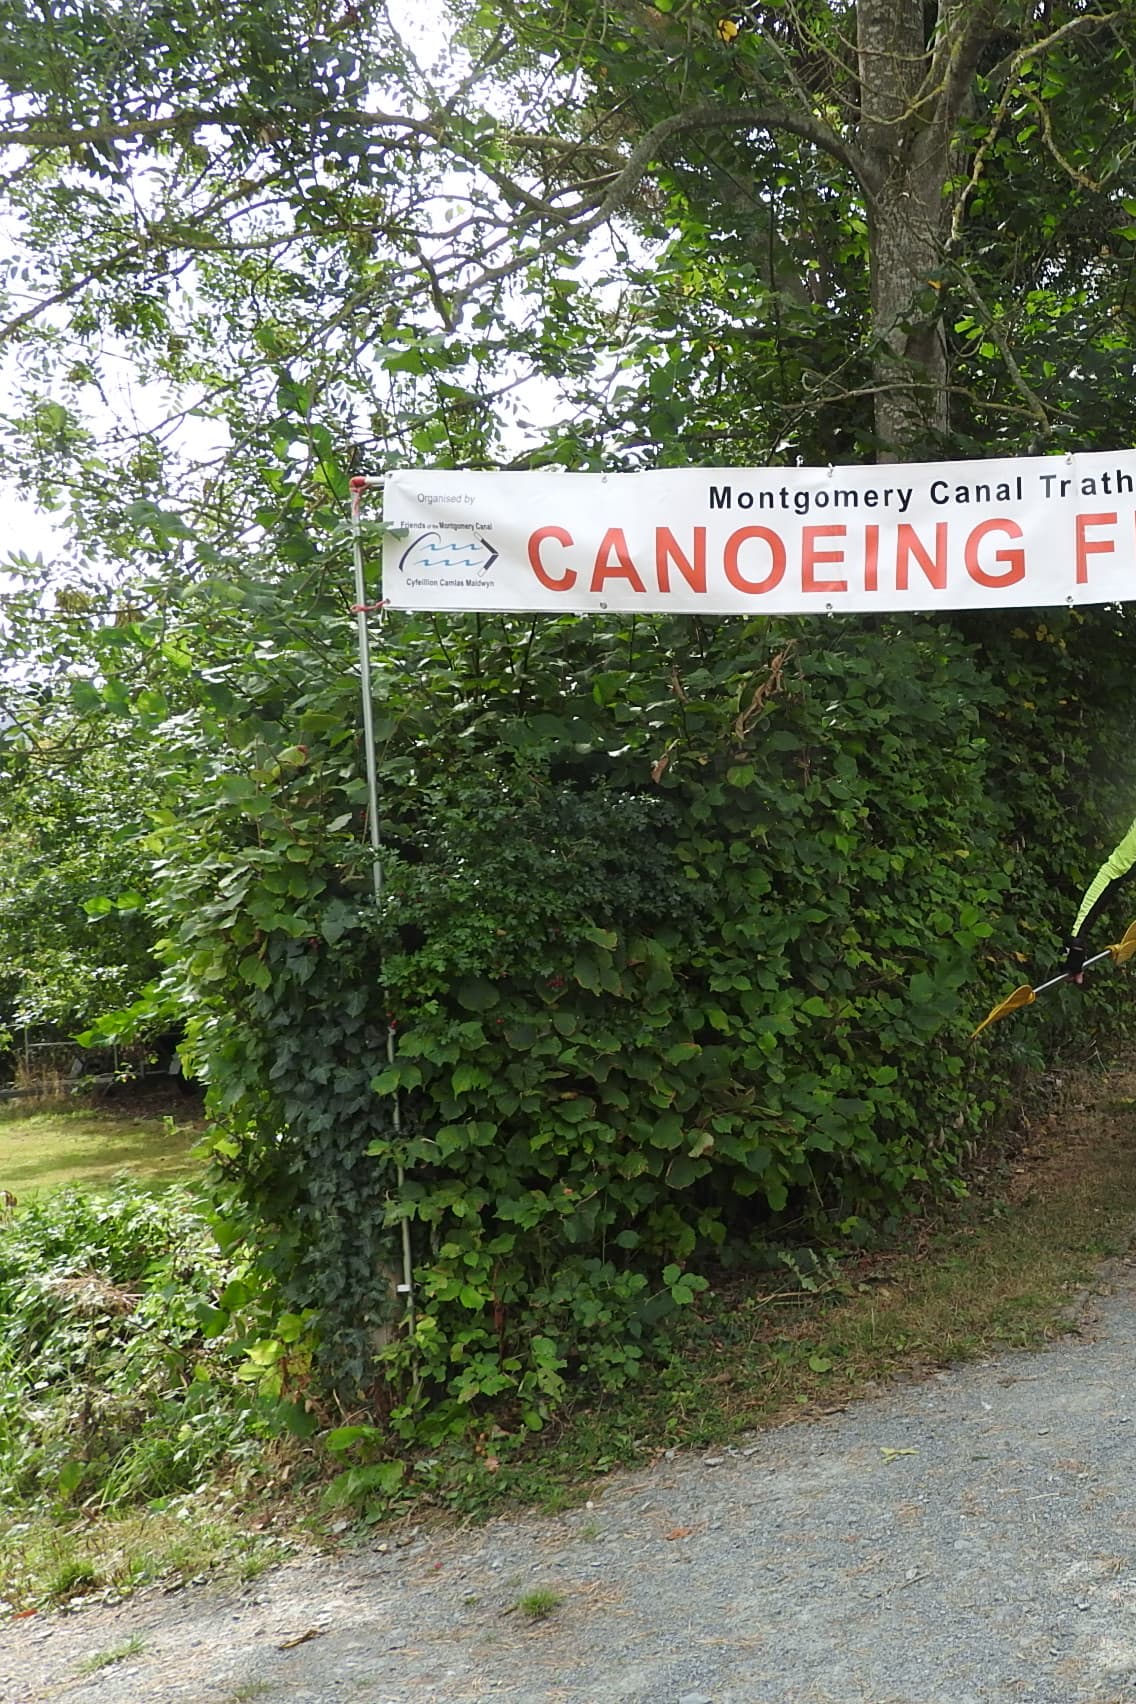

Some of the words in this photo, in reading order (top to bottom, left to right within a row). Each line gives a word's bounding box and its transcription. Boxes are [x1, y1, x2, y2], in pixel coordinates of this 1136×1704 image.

[417, 493, 462, 505] Organised
[464, 494, 476, 506] by
[709, 484, 913, 515] Montgomery
[931, 476, 1023, 505] Canal
[528, 518, 1026, 594] CANOEING
